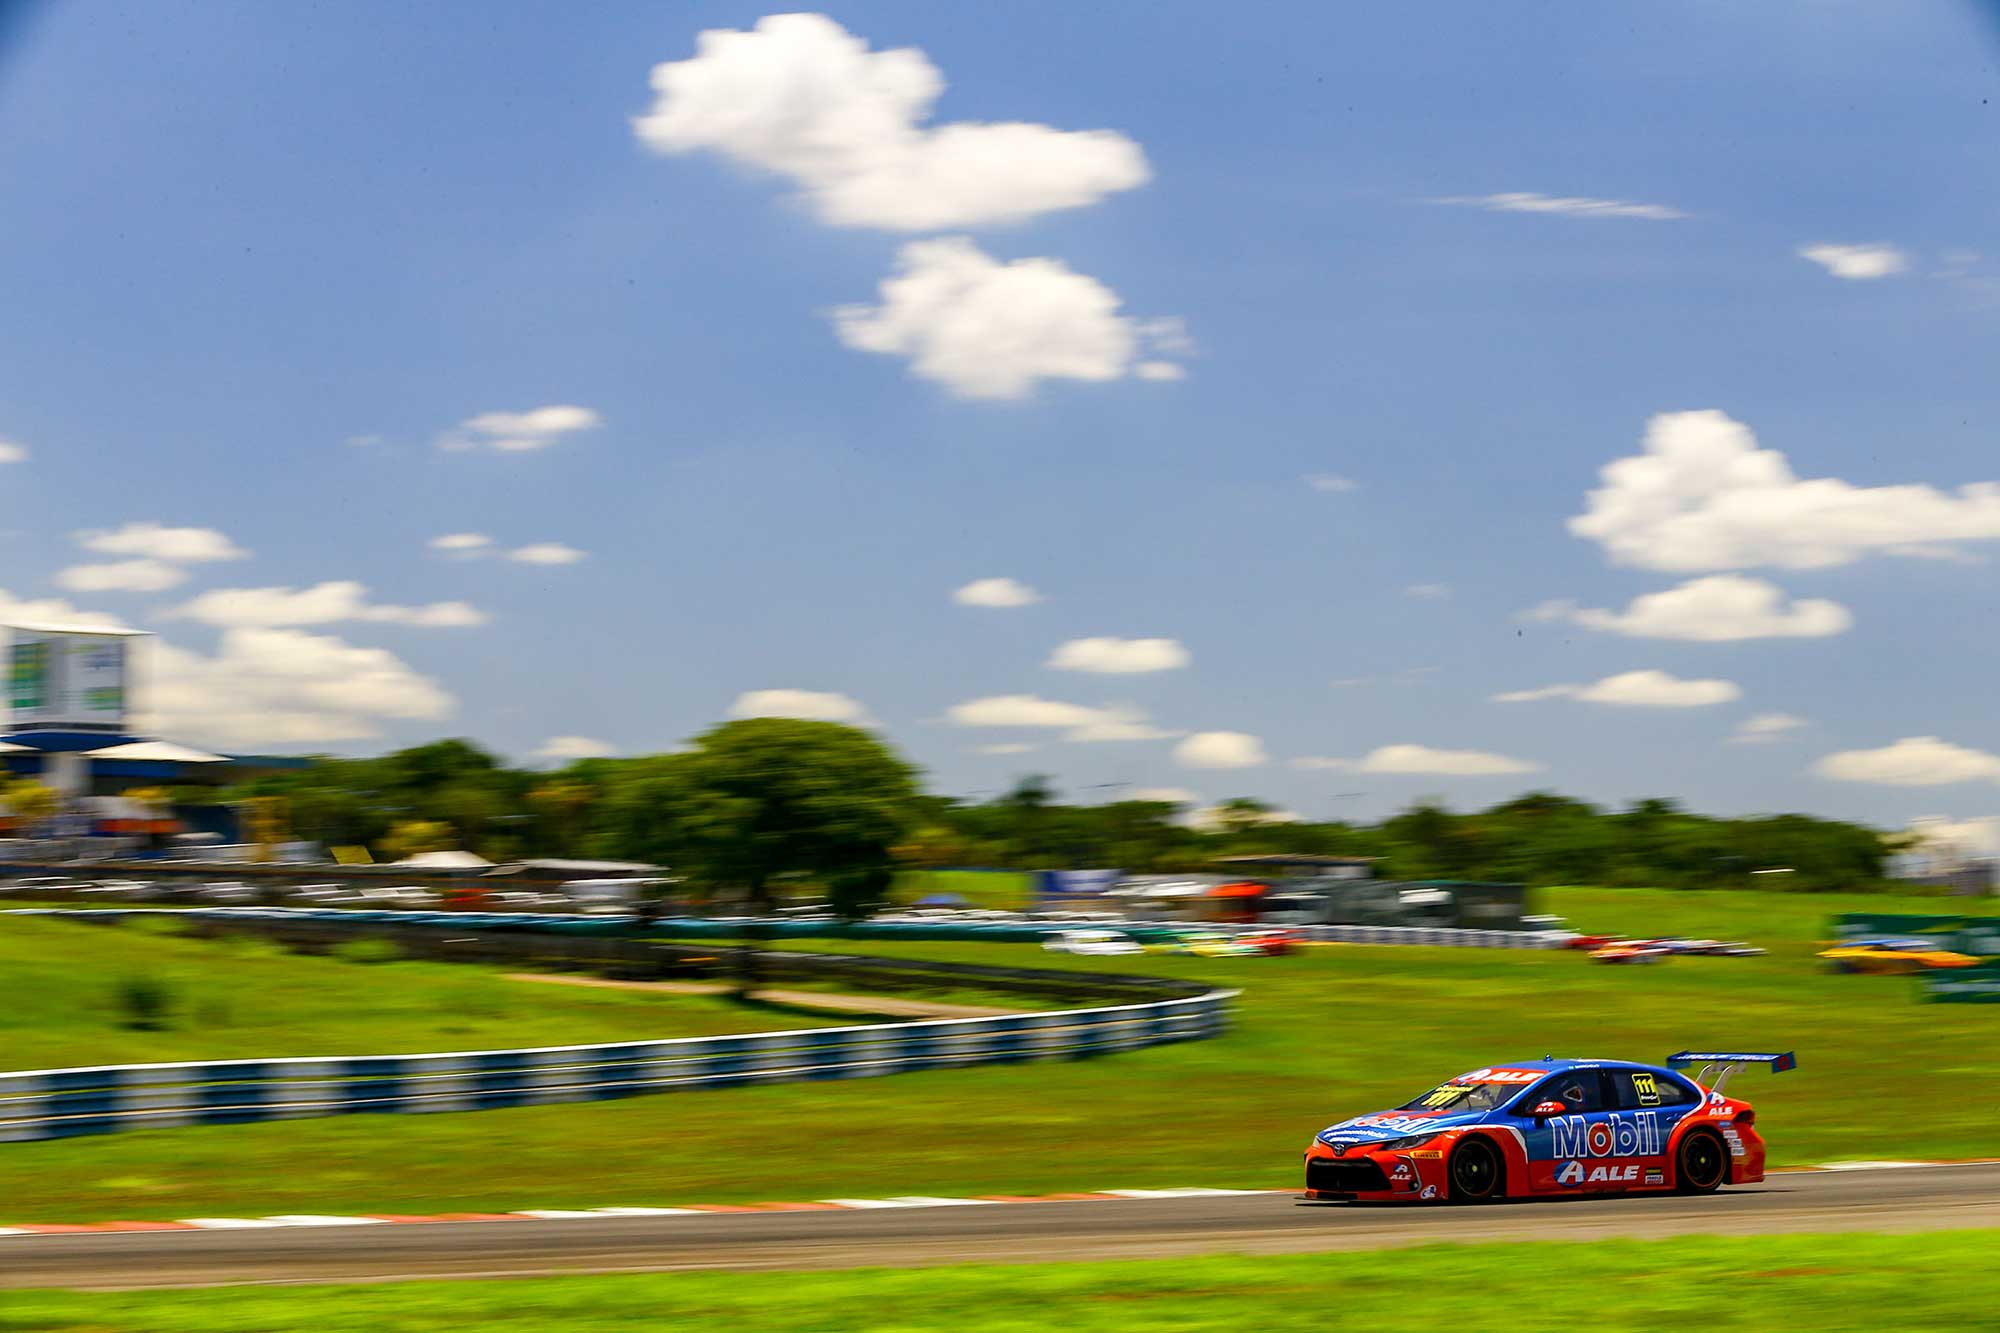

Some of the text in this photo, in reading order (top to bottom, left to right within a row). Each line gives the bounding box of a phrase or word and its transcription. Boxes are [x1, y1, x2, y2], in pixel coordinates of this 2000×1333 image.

[1482, 1072, 1545, 1082] ALE
[1634, 1079, 1657, 1093] 111
[1421, 1091, 1460, 1106] 111
[1709, 1106, 1733, 1116] ALE
[1549, 1112, 1660, 1159] Mobil
[1588, 1165, 1640, 1181] ALE
